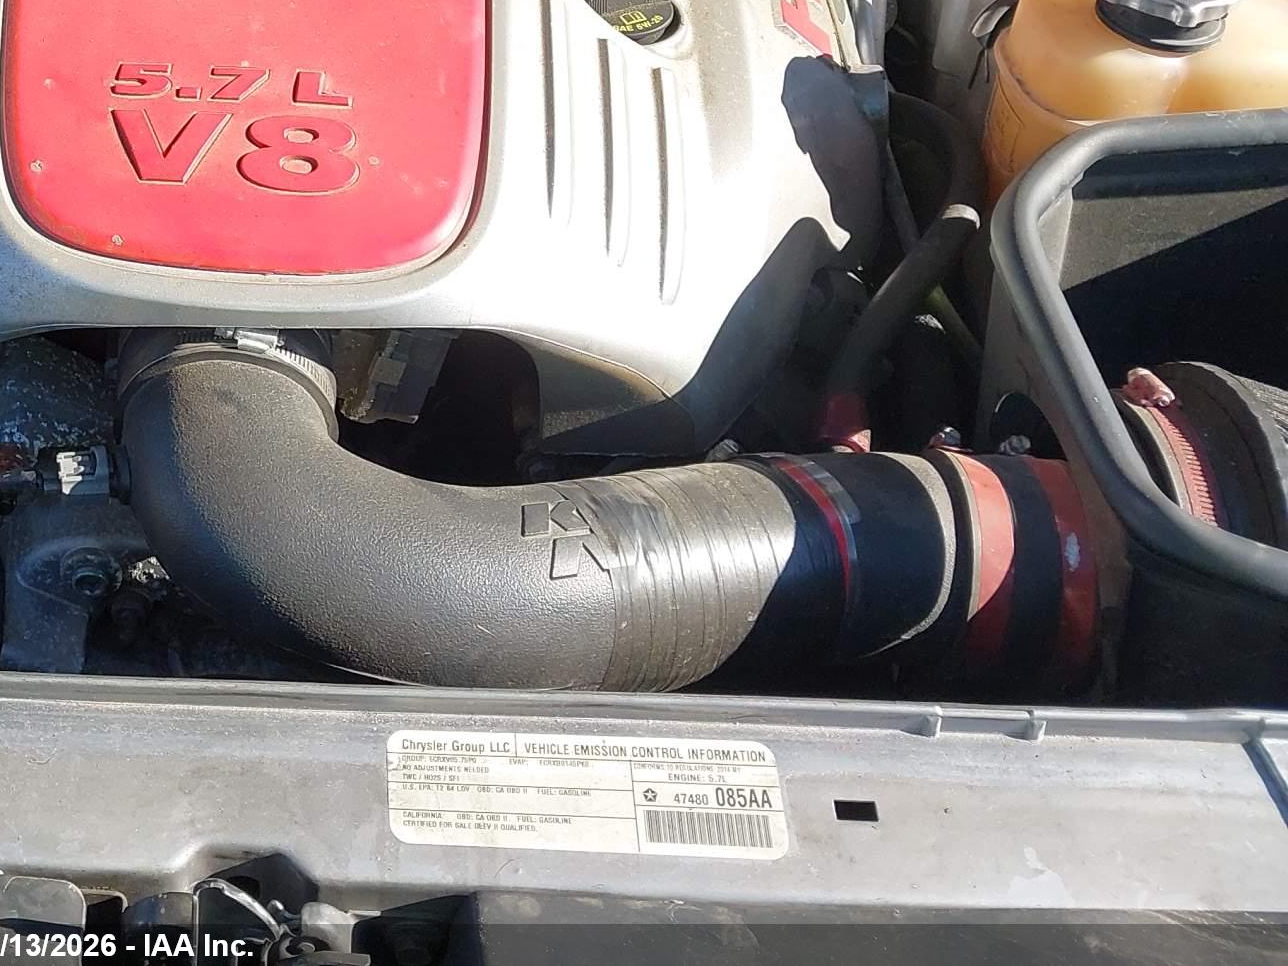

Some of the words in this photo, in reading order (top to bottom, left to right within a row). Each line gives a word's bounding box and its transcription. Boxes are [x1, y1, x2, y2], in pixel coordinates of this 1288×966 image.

[109, 107, 360, 196] V8
[402, 739, 447, 753] Chrysler
[451, 740, 485, 754] Group
[490, 742, 510, 753] LLC
[524, 743, 569, 755] VEHICLE
[574, 744, 627, 757] EMISSION
[632, 747, 683, 759] CONTROL
[688, 748, 766, 762] INFORMATION
[413, 765, 461, 773] ADJUSTMENTS
[668, 773, 705, 782] ENGINE:
[708, 774, 727, 783] 5.7L
[674, 793, 709, 805] 47480
[715, 787, 772, 808] 085AA
[403, 820, 437, 828] CERTIFIED
